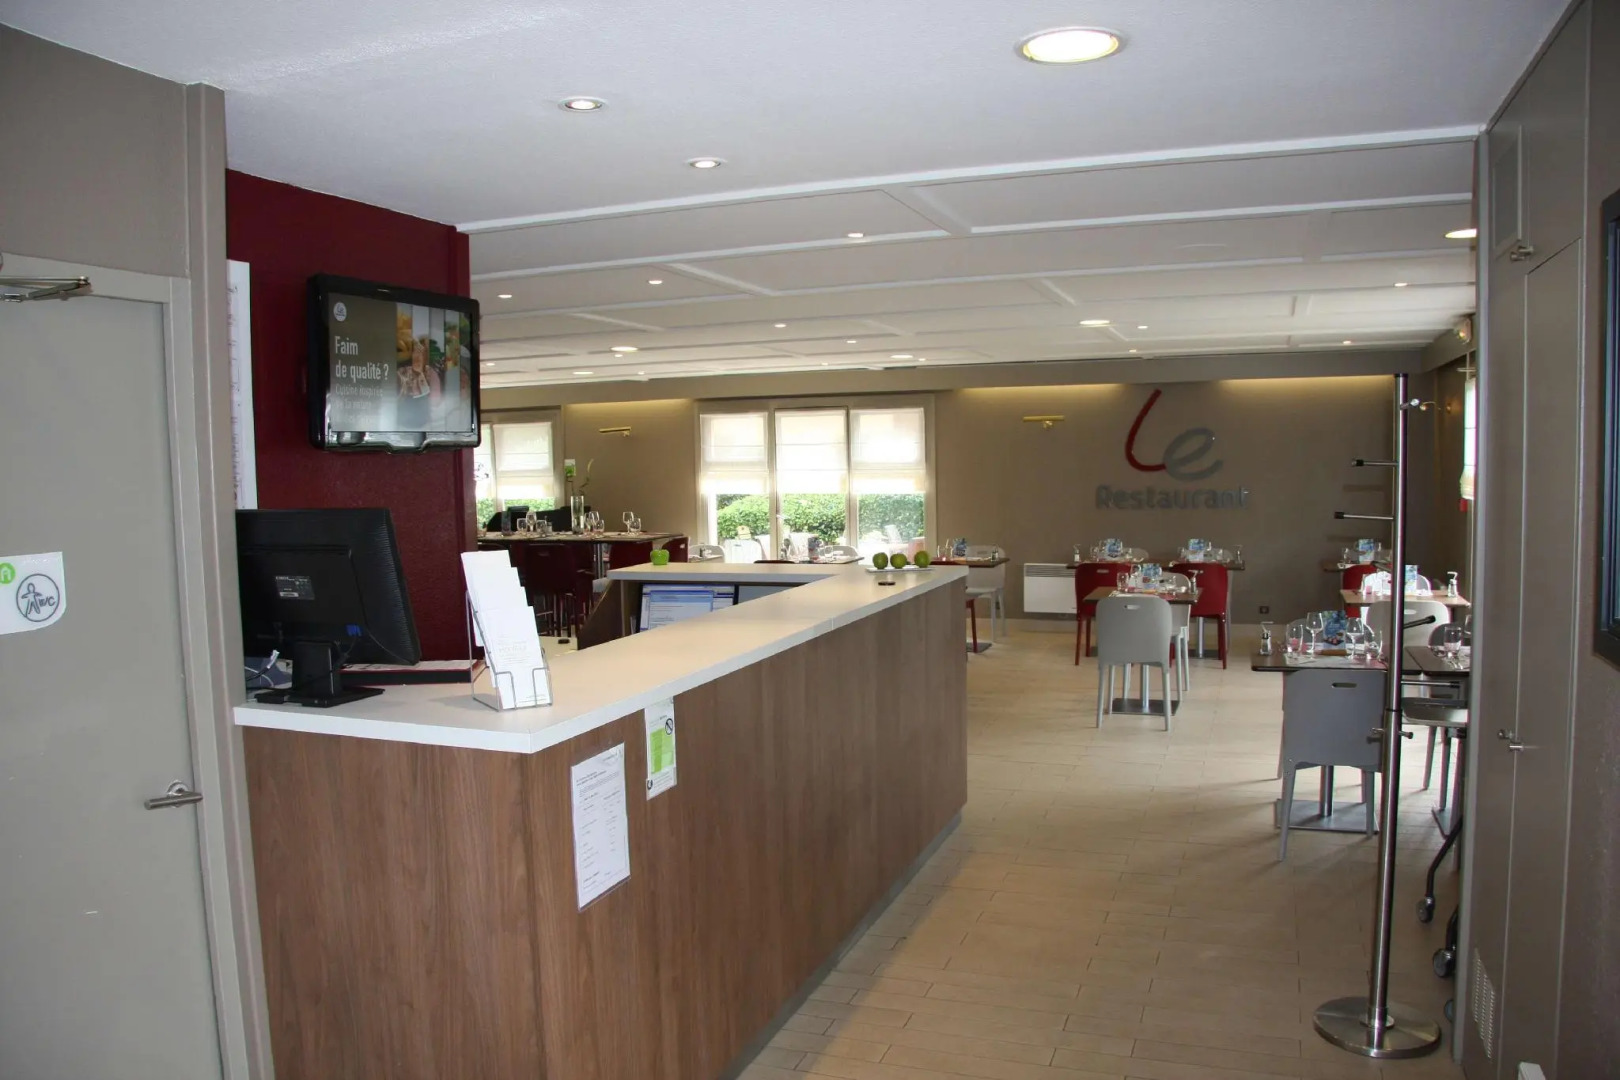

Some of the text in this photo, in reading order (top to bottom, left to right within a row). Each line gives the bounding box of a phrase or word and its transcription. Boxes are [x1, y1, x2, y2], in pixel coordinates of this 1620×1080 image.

[334, 336, 358, 355] Faim
[335, 360, 389, 382] de qualité ?
[1095, 484, 1248, 510] Restaurant
